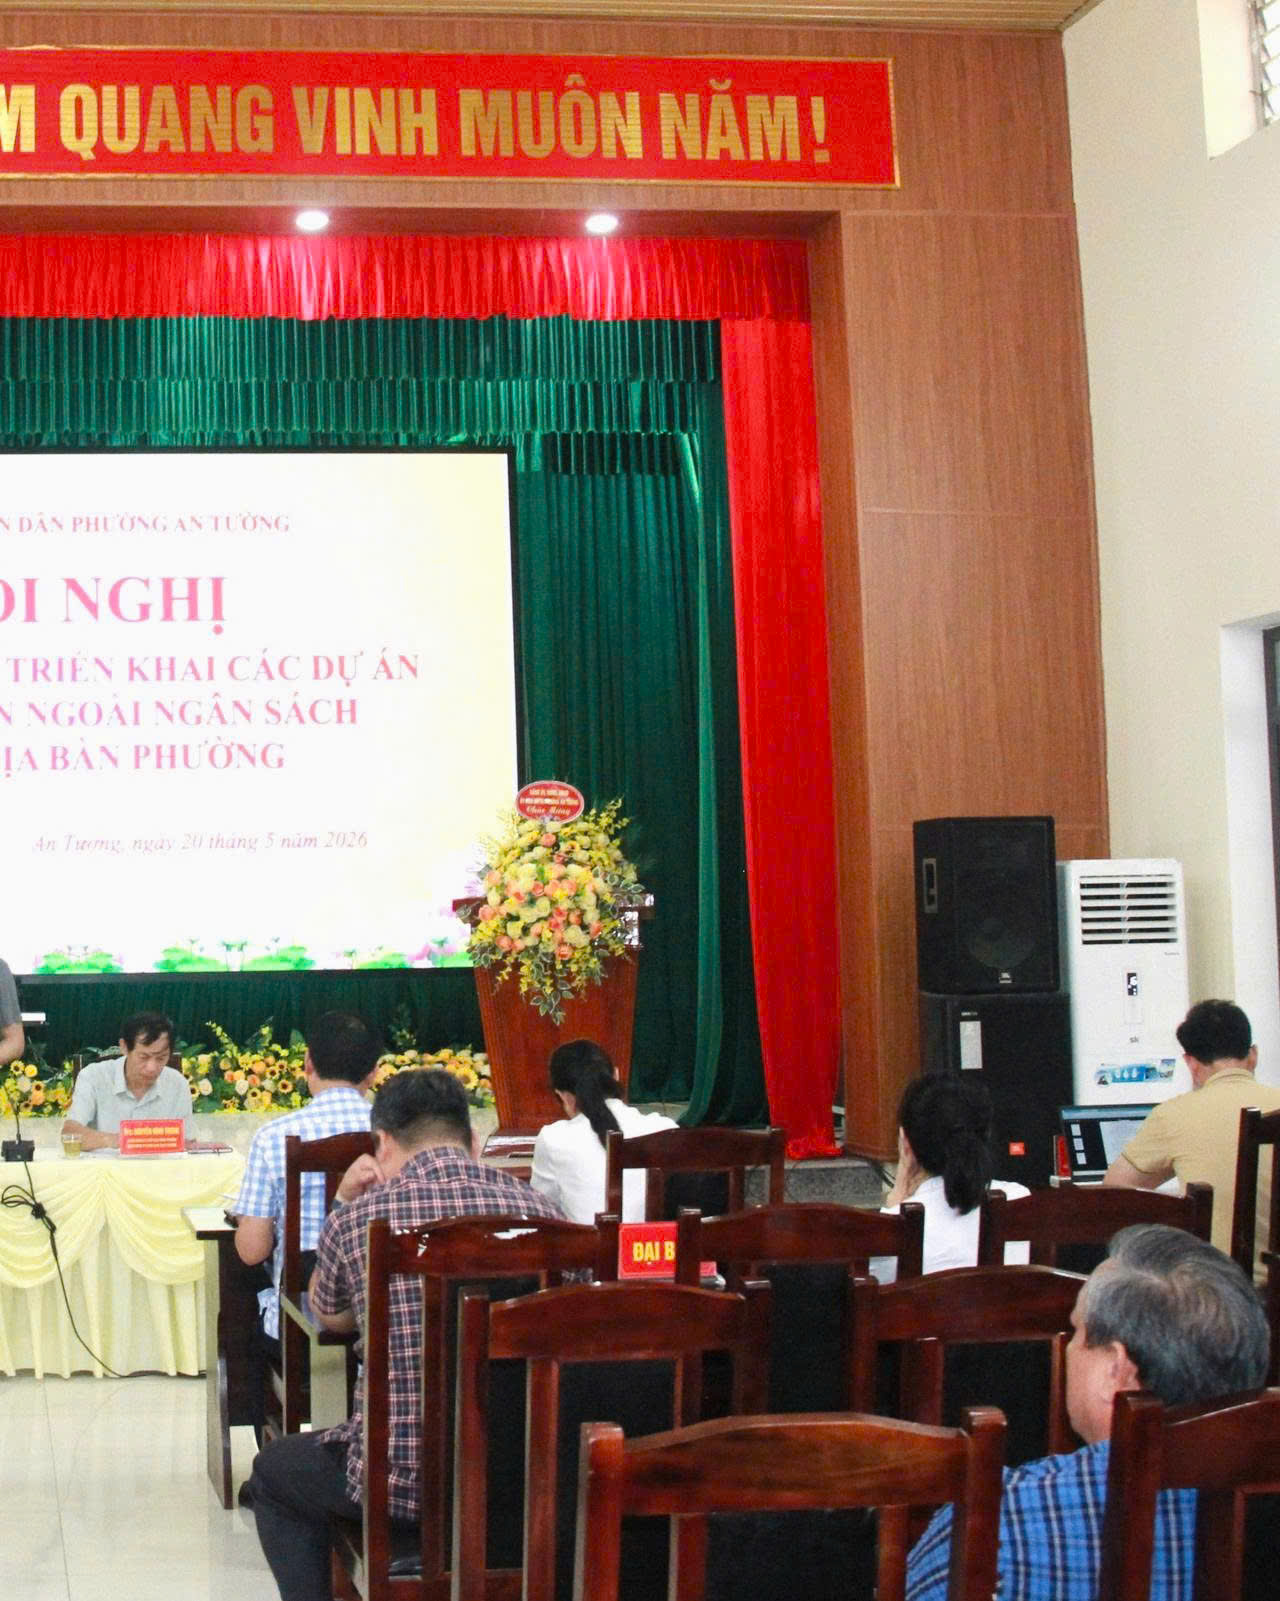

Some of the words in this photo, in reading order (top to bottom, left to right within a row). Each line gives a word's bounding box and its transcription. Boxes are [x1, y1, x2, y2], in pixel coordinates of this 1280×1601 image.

[59, 83, 276, 162] QUANG
[291, 86, 440, 157] VINH
[460, 73, 643, 160] MUÔN
[18, 510, 64, 533] DÂN
[175, 515, 205, 532] AN
[62, 575, 228, 636] NGHỊ
[127, 655, 216, 682] KHAI
[227, 647, 301, 681] CÁC
[312, 650, 365, 688] DỰ
[372, 647, 420, 681] ÁN
[154, 692, 253, 726] NGÂN
[264, 691, 360, 725] SÁCH
[49, 738, 120, 771] BÀN
[133, 736, 285, 770] PHƯỜNG
[632, 1241, 660, 1265] ĐẠI
